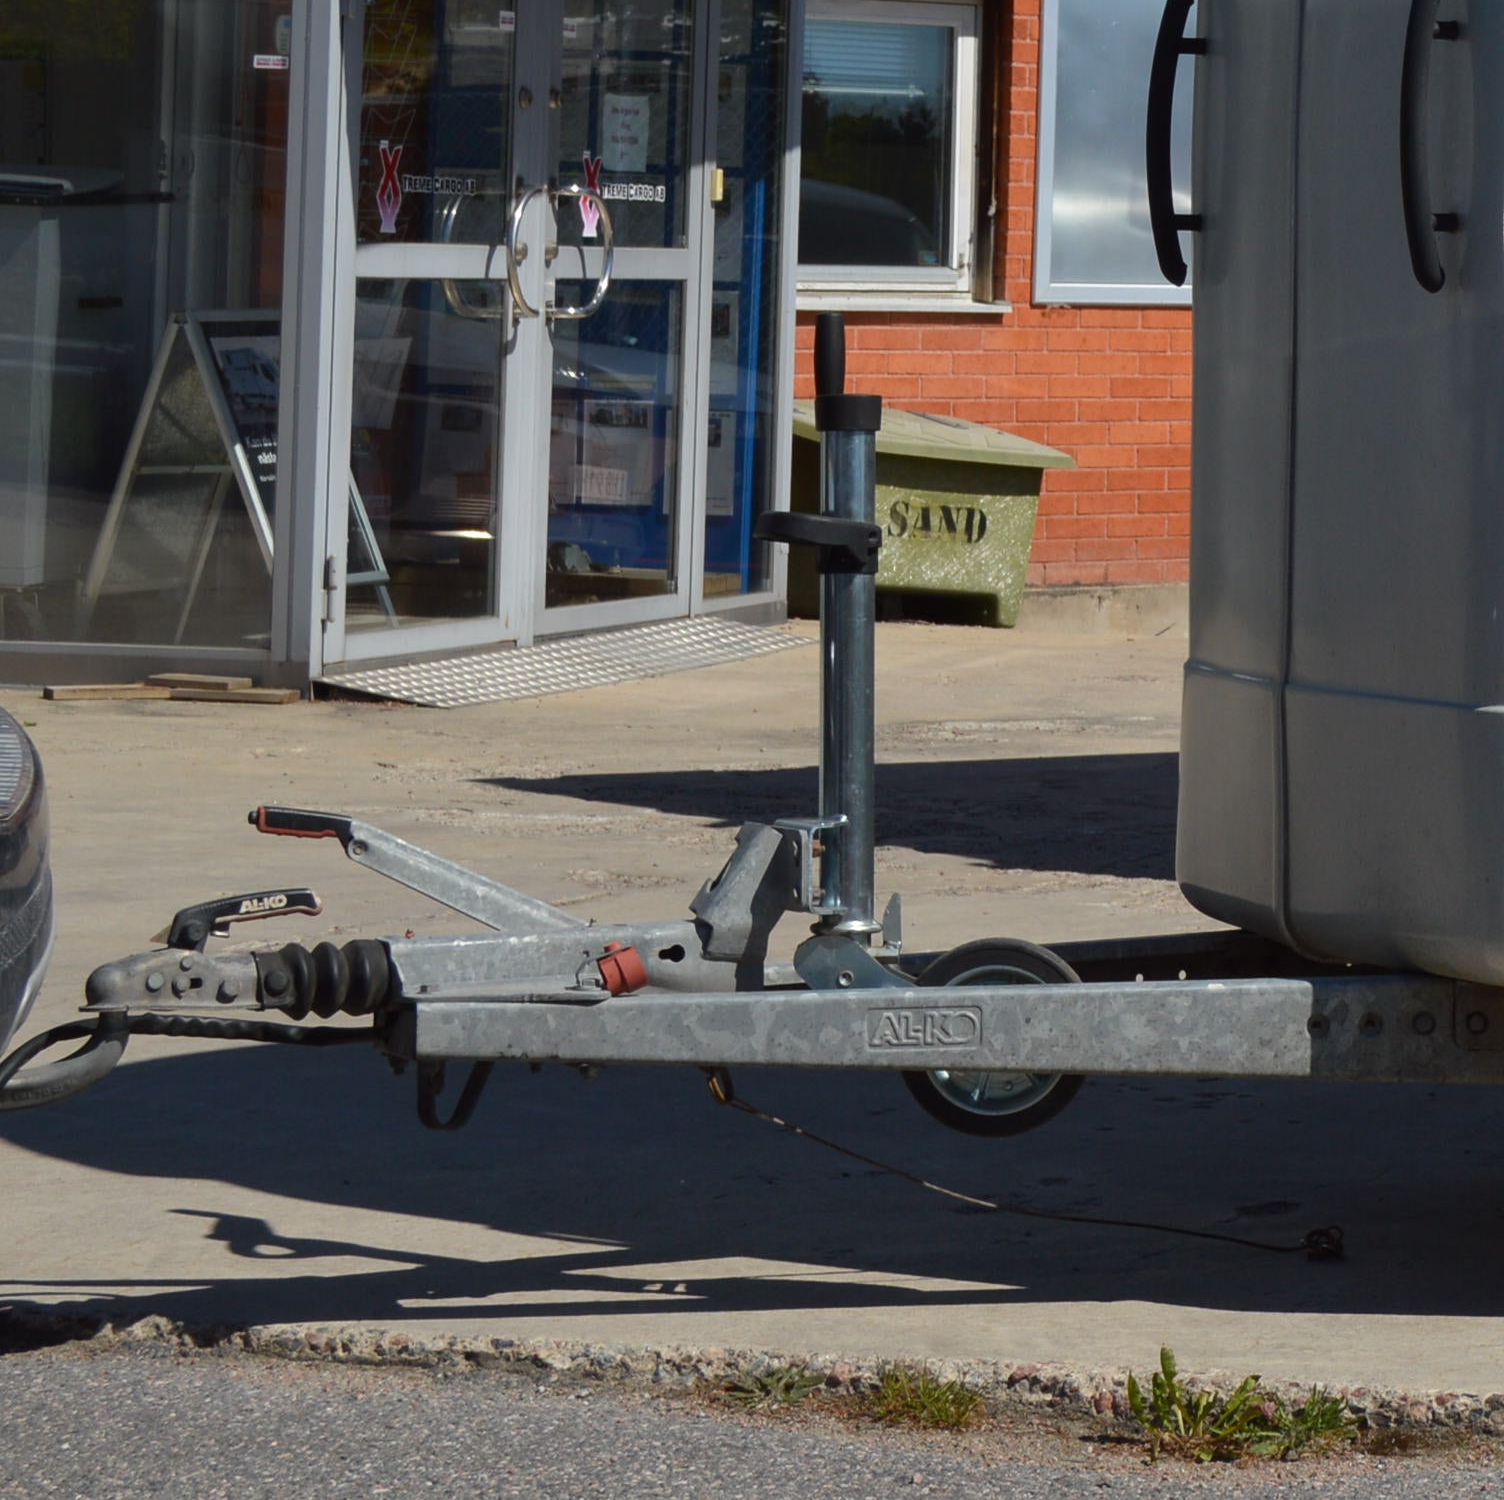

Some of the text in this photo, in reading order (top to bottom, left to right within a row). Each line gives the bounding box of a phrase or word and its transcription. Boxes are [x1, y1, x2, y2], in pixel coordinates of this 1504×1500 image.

[433, 176, 464, 194] CARGO
[464, 178, 477, 195] AB
[628, 183, 654, 201] CARGO
[654, 185, 666, 202] AB
[887, 500, 988, 544] SAND
[868, 1011, 980, 1047] AL-KO
